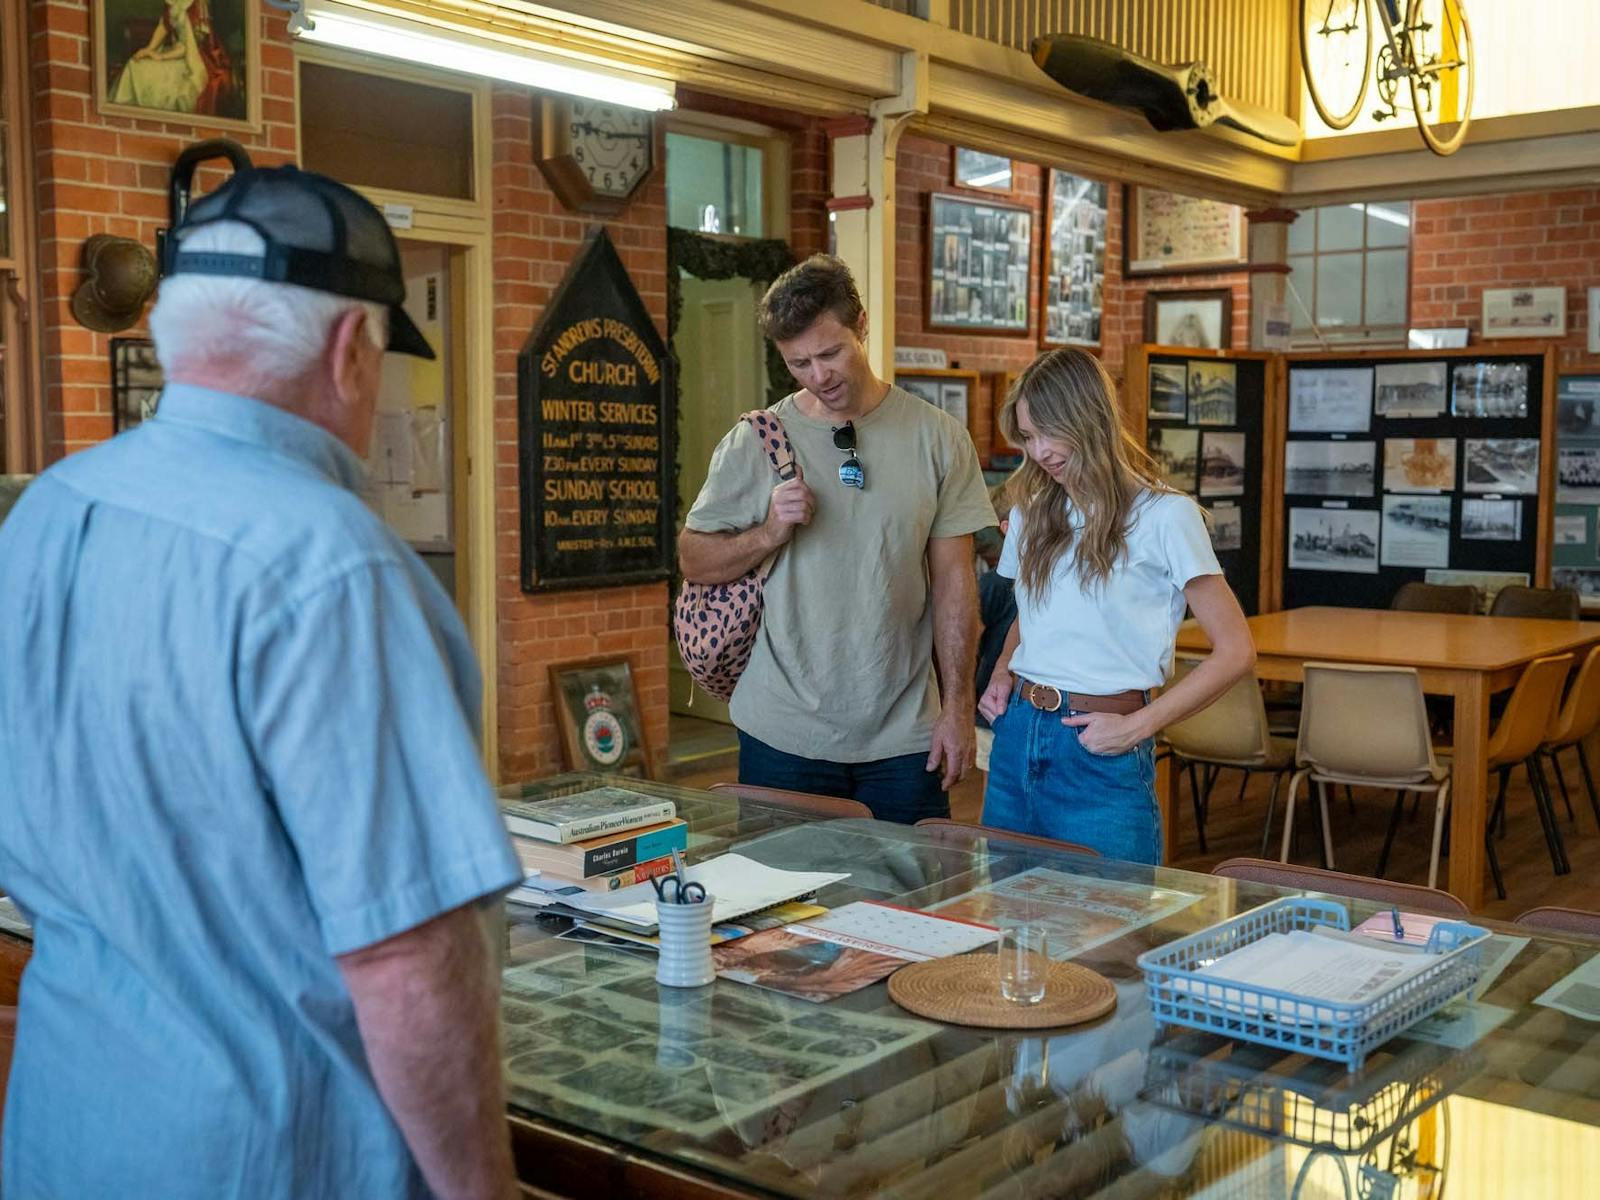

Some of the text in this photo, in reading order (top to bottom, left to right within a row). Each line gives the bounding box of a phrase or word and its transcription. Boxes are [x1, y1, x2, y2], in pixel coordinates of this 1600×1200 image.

[575, 146, 585, 163] 8
[588, 166, 596, 182] 7
[604, 172, 612, 191] 6
[619, 171, 628, 191] 5
[568, 359, 637, 386] CHURCH
[541, 399, 657, 425] WINTER SERVICES
[580, 457, 615, 472] EVERY
[617, 457, 657, 472] SUNDAY
[544, 479, 659, 501] SUNDAY SCHOOL
[572, 509, 608, 526] EVERY
[613, 508, 657, 525] SUNDAY
[570, 822, 600, 837] Australian
[600, 817, 624, 830] Pioneer
[623, 814, 643, 826] Women
[592, 852, 611, 863] Charles
[612, 846, 629, 857] Darwin
